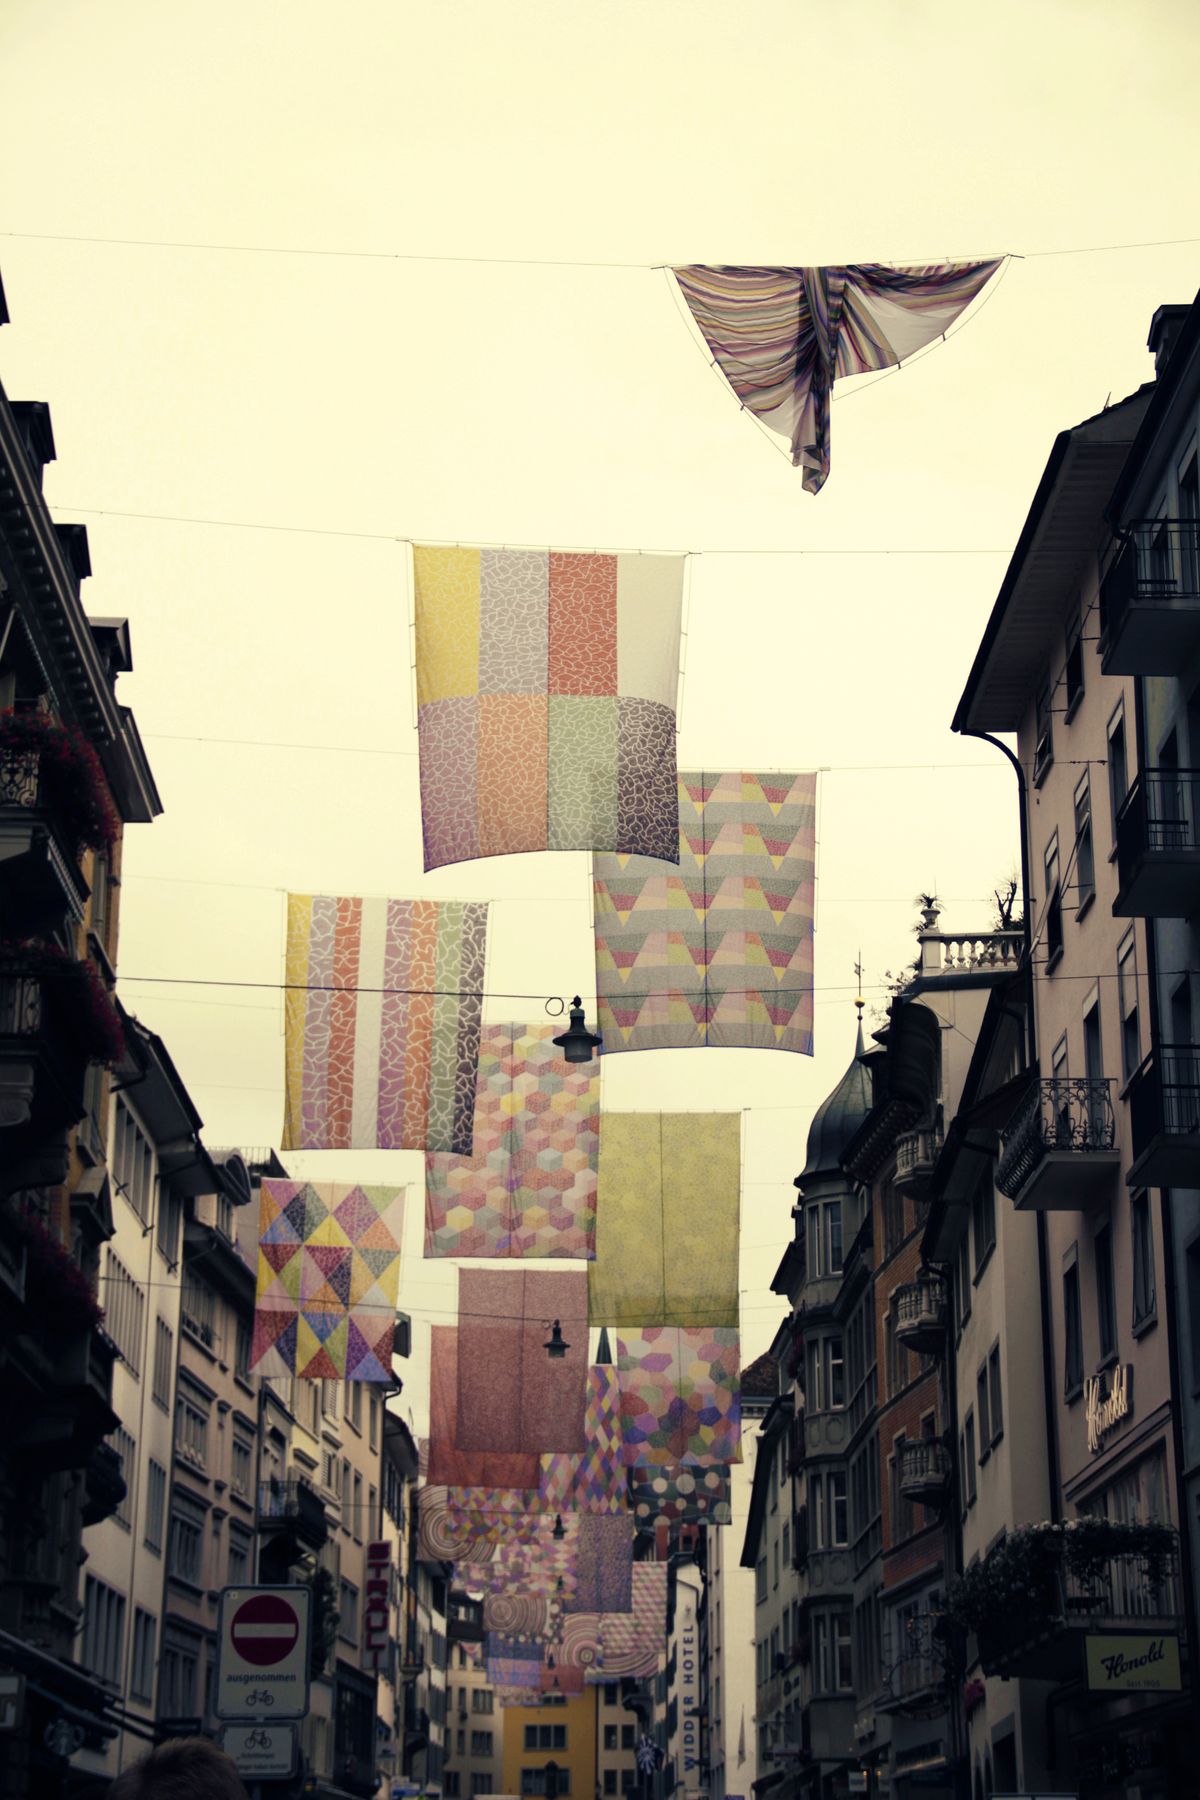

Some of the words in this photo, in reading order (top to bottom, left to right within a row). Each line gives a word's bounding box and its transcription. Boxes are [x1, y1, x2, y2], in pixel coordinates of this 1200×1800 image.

[226, 1674, 297, 1685] ausgenommen
[682, 1624, 694, 1684] HOTEL
[1100, 1639, 1165, 1681] Honold
[682, 1696, 694, 1773] WIDDER
